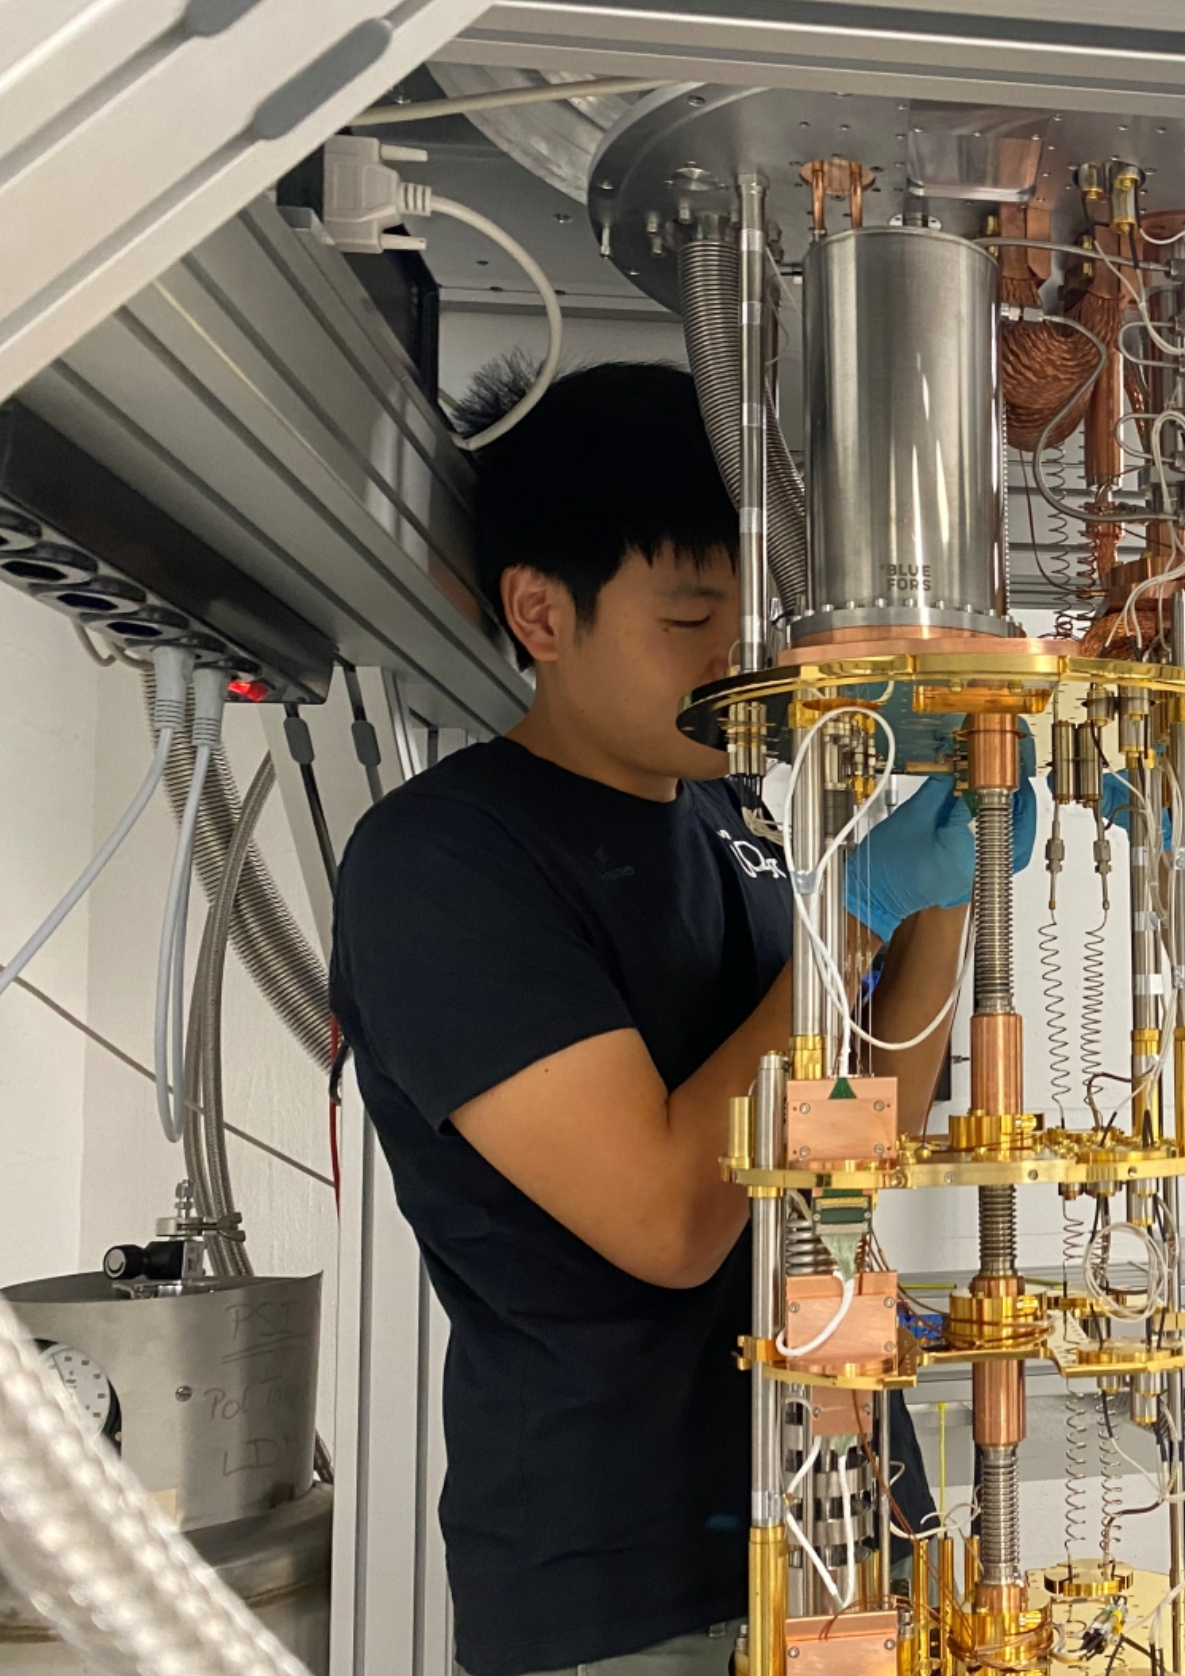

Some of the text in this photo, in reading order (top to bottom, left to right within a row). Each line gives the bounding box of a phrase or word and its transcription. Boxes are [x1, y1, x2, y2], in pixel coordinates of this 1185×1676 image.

[886, 564, 931, 577] BLUE
[886, 578, 932, 591] FORS
[225, 1302, 302, 1340] PSI
